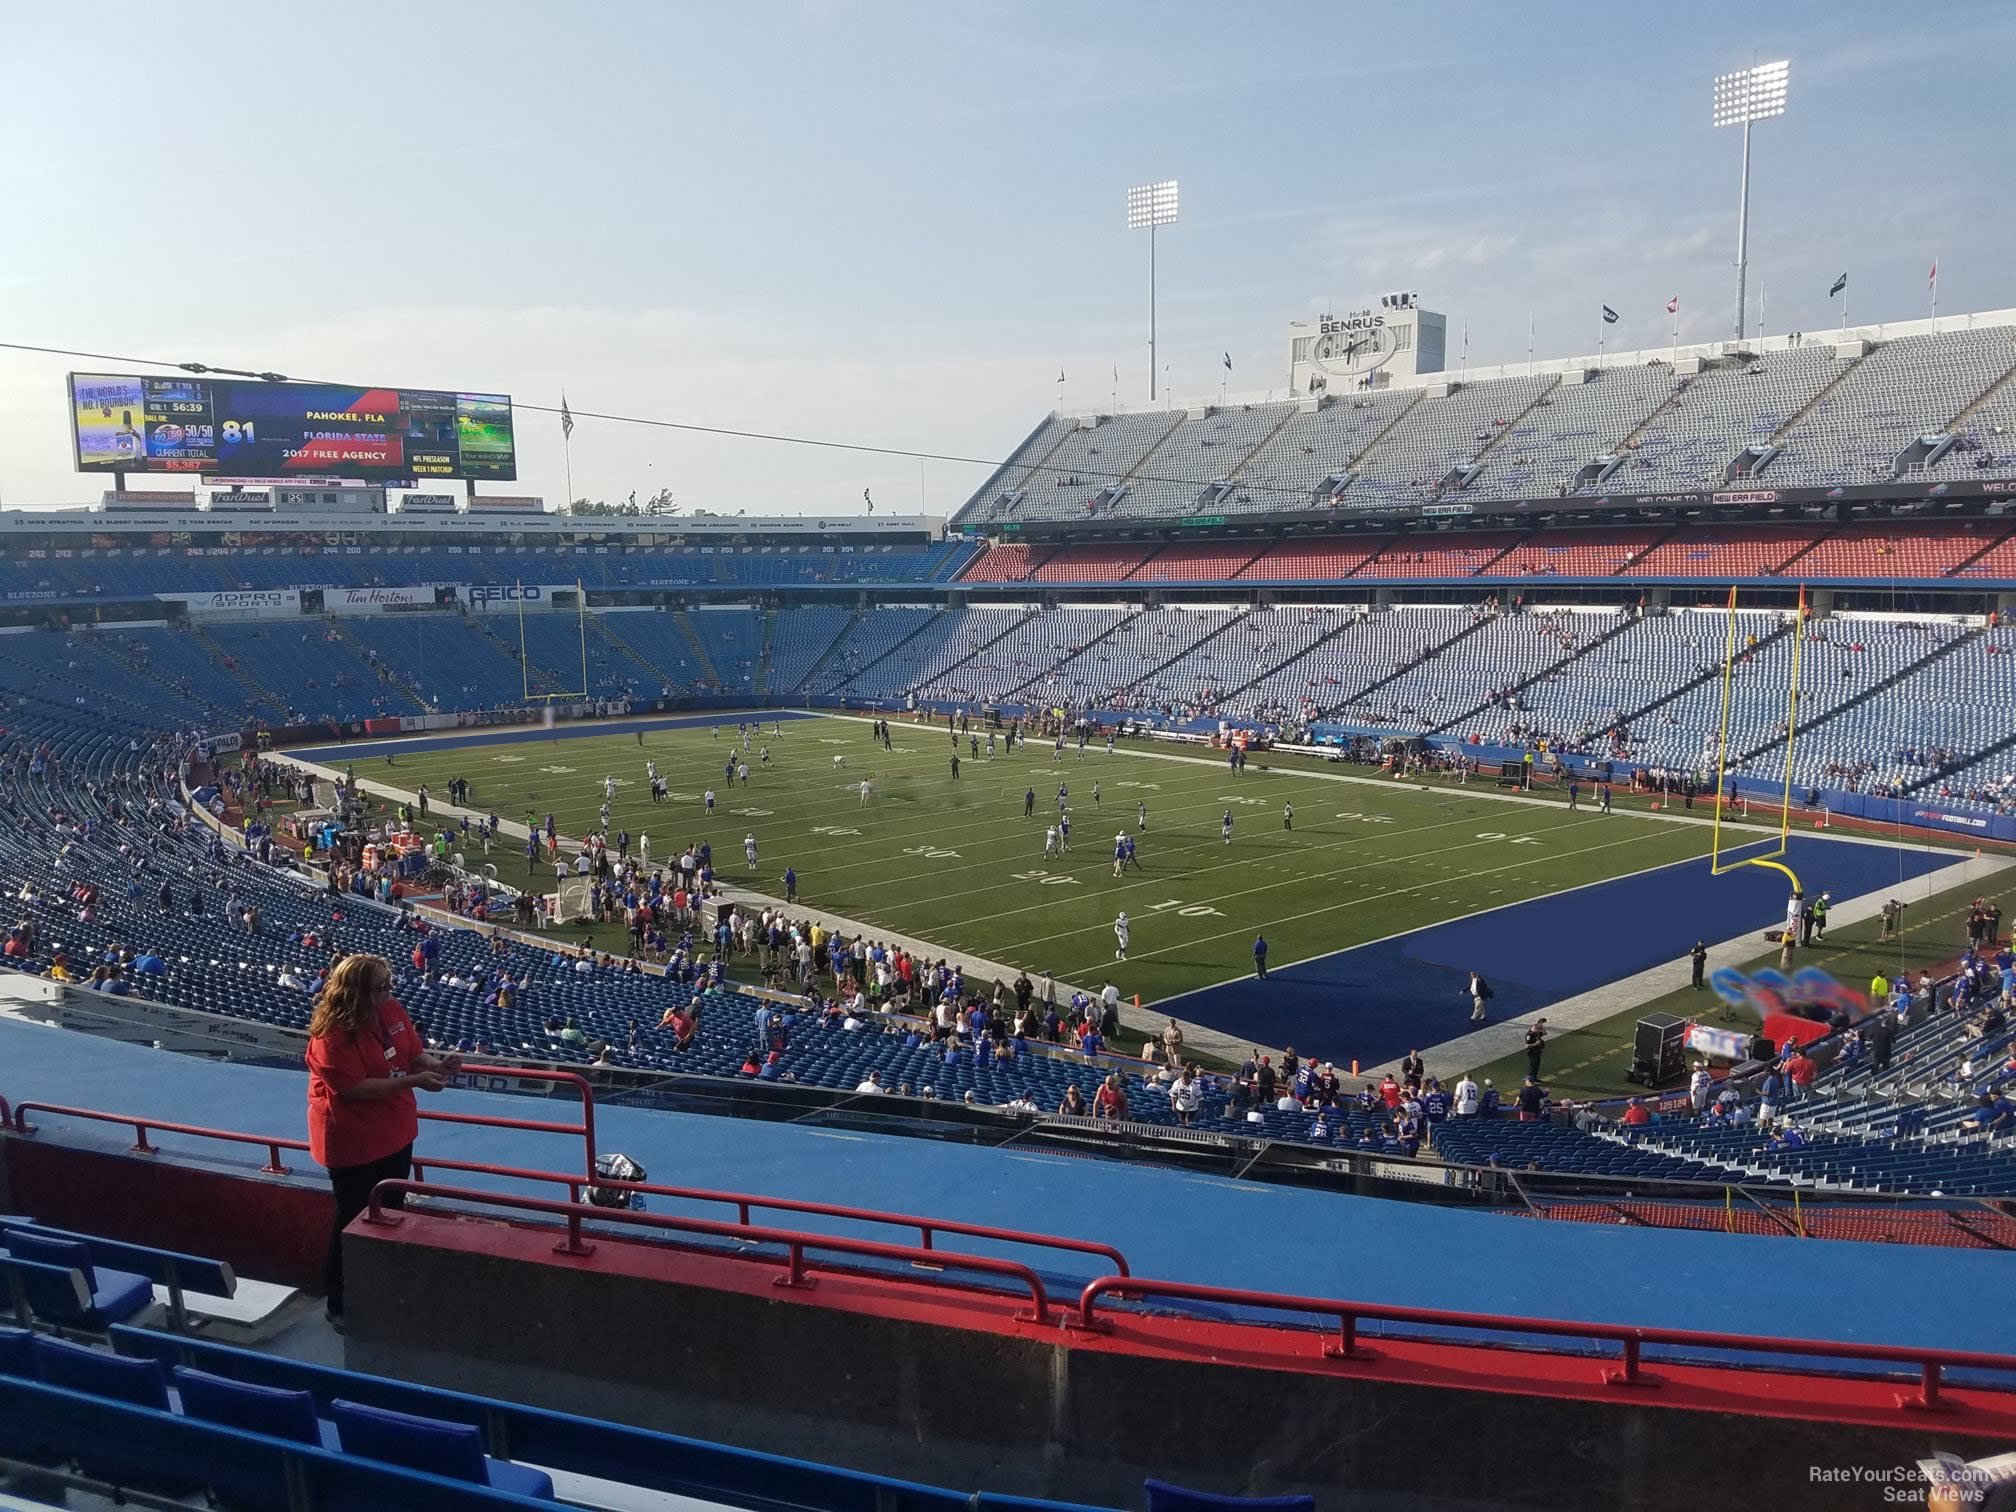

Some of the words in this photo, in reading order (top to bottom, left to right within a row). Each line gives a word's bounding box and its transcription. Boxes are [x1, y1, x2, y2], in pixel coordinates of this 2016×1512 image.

[1320, 316, 1384, 334] BENRUS
[81, 388, 95, 399] THE
[97, 385, 128, 397] WORLD'S
[172, 402, 203, 412] 56:39
[306, 411, 361, 422] PAHOKEE,
[365, 413, 385, 422] FLA
[185, 425, 213, 438] 50/50
[222, 420, 256, 444] 81
[304, 431, 351, 441] FLORIDA
[354, 433, 386, 442] STATE
[156, 448, 186, 458] CURRENT
[188, 449, 208, 458] TOTAL
[282, 449, 309, 458] 2017
[313, 450, 339, 459] FREE
[343, 451, 387, 460] AGENCY
[423, 455, 450, 463] PRESEASON
[215, 491, 266, 502] FanDuel
[406, 495, 452, 504] FanDuel
[1732, 494, 1748, 502] ERA
[1750, 493, 1774, 501] FIELD
[29, 550, 46, 558] 242
[213, 548, 229, 556] 244
[8, 591, 57, 599] BLUEZONE
[211, 593, 281, 602] ADPRO
[346, 591, 367, 603] Tim
[369, 589, 413, 603] Hortons
[468, 586, 541, 601] GEICO
[903, 846, 957, 858] 30
[1010, 869, 1074, 885] 20
[1179, 1088, 1191, 1100] 25
[1467, 1088, 1476, 1101] 13
[1429, 1102, 1444, 1114] 25
[1659, 1100, 1673, 1110] 125
[1673, 1098, 1687, 1108] 124
